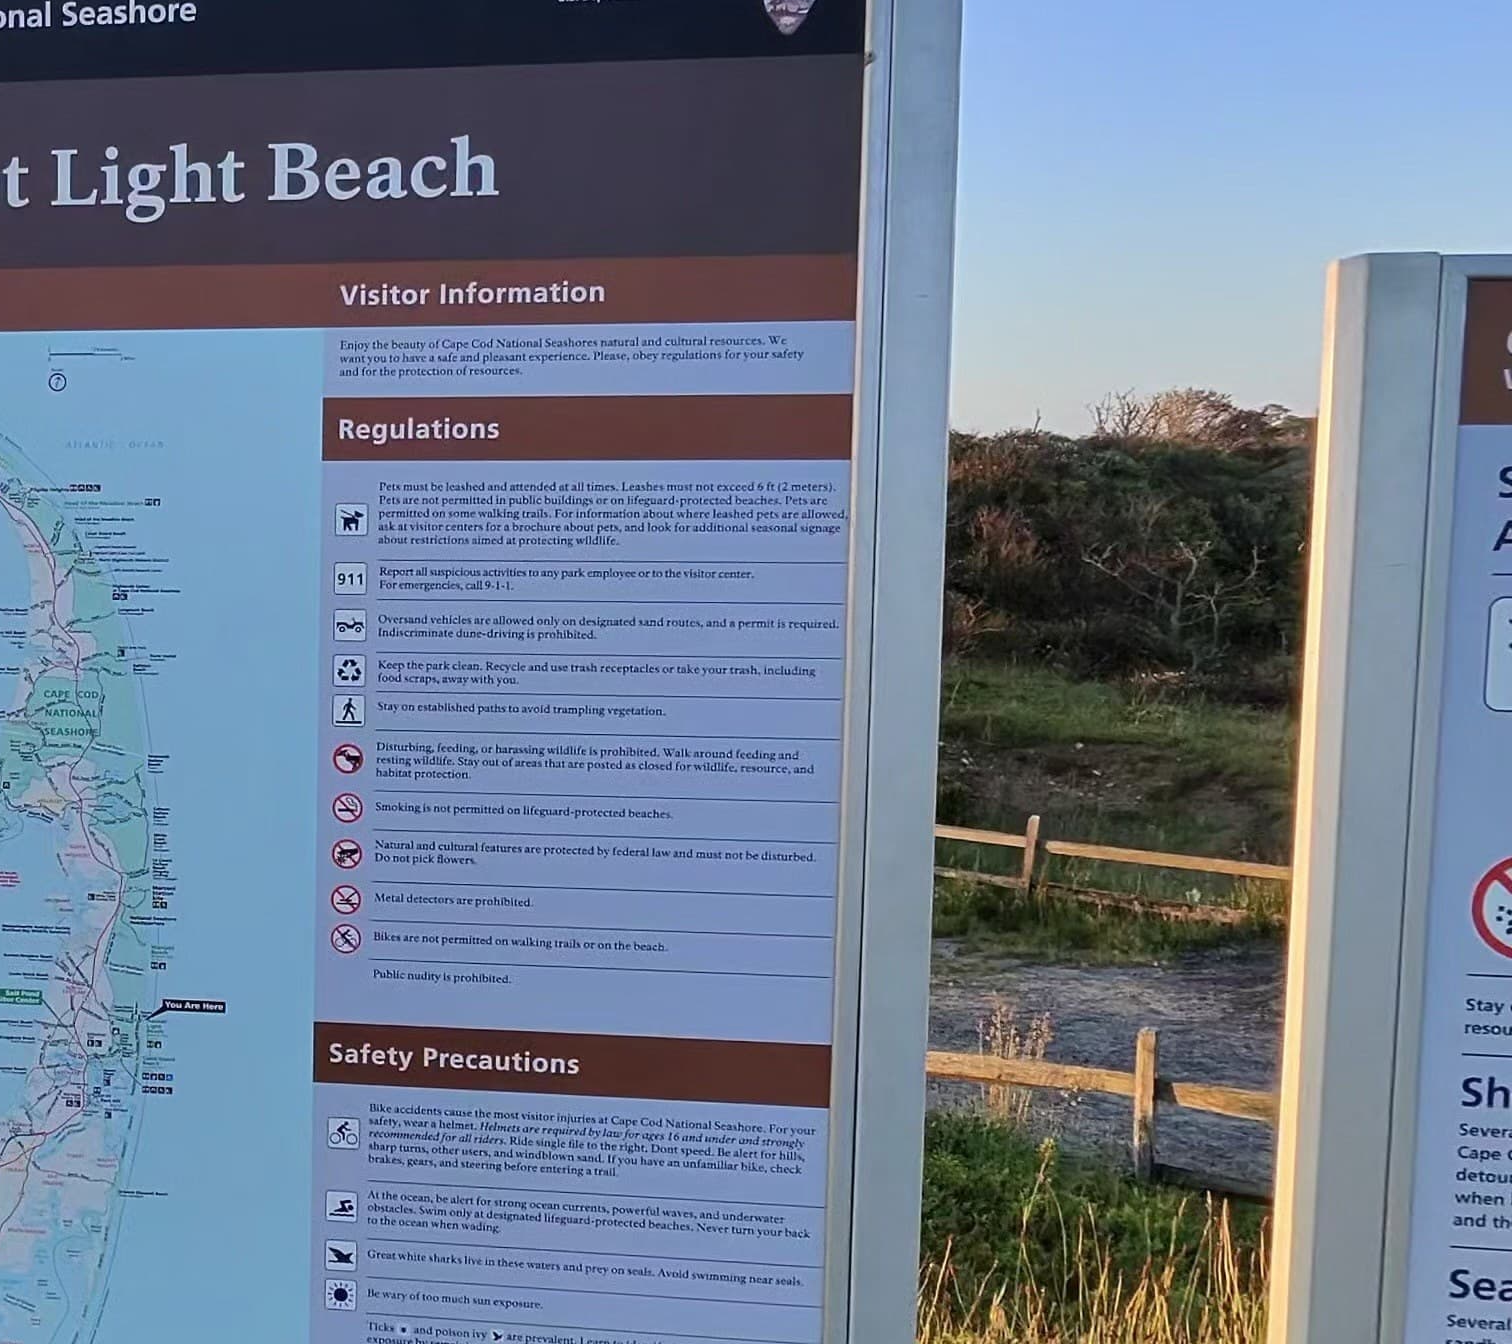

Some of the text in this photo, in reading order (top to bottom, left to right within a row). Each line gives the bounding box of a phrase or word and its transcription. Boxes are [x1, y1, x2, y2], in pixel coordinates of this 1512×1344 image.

[51, 143, 244, 222] Light
[268, 134, 498, 200] Beach
[340, 280, 604, 305] Visitor Information
[340, 340, 369, 352] Enjoy
[372, 339, 388, 350] the
[391, 339, 426, 351] beauty
[428, 338, 440, 349] of
[441, 339, 468, 351] Cape
[471, 338, 493, 348] Cod
[496, 337, 542, 348] National
[544, 337, 597, 347] Seashores
[600, 336, 638, 347] natural
[641, 336, 661, 346] and
[664, 335, 706, 346] cultural
[768, 335, 786, 344] We
[340, 355, 365, 363] want
[367, 355, 386, 365] you
[389, 354, 400, 363] to
[402, 352, 426, 362] have
[437, 352, 457, 362] safe
[459, 351, 479, 362] and
[482, 352, 526, 364] pleasant
[632, 350, 658, 363] obey
[661, 349, 721, 362] regulations
[724, 348, 741, 359] for
[743, 351, 769, 361] your
[771, 348, 804, 361] safety
[339, 366, 358, 376] and
[361, 366, 377, 376] for
[379, 366, 396, 376] the
[398, 368, 453, 379] protection
[456, 365, 467, 375] of
[339, 417, 499, 444] Regulations
[337, 573, 363, 585] 911
[379, 566, 413, 579] Report
[415, 566, 427, 576] all
[430, 567, 481, 579] suspicious
[482, 567, 526, 577] activities
[528, 569, 539, 577] to
[540, 570, 559, 580] any
[561, 568, 584, 579] park
[587, 567, 636, 580] employee
[664, 568, 681, 578] the
[683, 568, 716, 578] visitor
[44, 690, 99, 699] CAPE COD
[45, 709, 97, 717] NATIONAL
[377, 701, 399, 713] Stay
[417, 702, 474, 712] established
[477, 703, 505, 715] paths
[508, 705, 519, 713] to
[521, 704, 550, 713] avoid
[553, 704, 605, 717] trampling
[44, 727, 98, 736] SEASHORE
[373, 968, 405, 979] Public
[407, 971, 441, 983] nudity
[443, 972, 450, 981] is
[165, 1000, 224, 1011] You Are Here
[1465, 998, 1505, 1015] Stay
[330, 1043, 578, 1073] Safety Precautions
[1461, 1076, 1510, 1108] Sh
[1457, 1145, 1502, 1162] Cape
[1455, 1191, 1505, 1206] when
[1453, 1214, 1486, 1228] and
[367, 1288, 379, 1298] Be
[382, 1291, 407, 1301] wary
[409, 1291, 420, 1300] of
[422, 1293, 439, 1302] too
[441, 1295, 469, 1304] much
[472, 1297, 490, 1305] sun
[1446, 1314, 1511, 1331] Several
